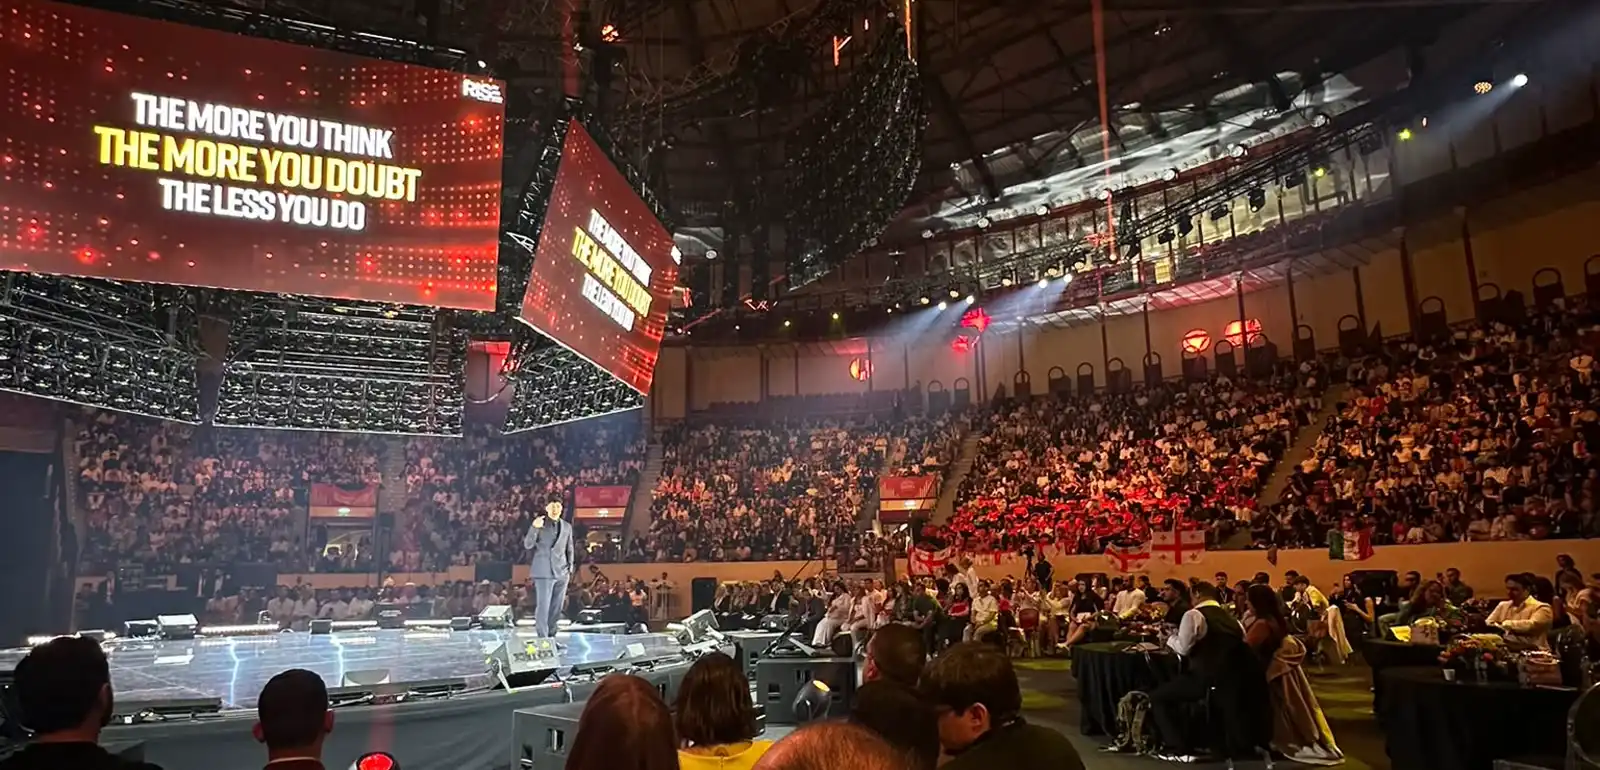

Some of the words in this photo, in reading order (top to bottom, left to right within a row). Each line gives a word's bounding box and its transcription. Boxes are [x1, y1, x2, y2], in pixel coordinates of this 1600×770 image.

[463, 79, 501, 99] RISE
[131, 92, 186, 130] THE
[187, 101, 265, 141] MORE
[266, 112, 318, 148] YOU
[319, 121, 393, 159] THINK
[94, 125, 160, 170] THE
[163, 135, 258, 182] MORE
[259, 148, 322, 190] YOU
[326, 157, 422, 202] DOUBT
[157, 178, 211, 214] THE
[213, 184, 276, 220] LESS
[278, 193, 328, 227] YOU
[331, 199, 366, 231] DO
[572, 226, 595, 267] THE
[590, 243, 617, 288] MORE
[613, 264, 632, 300] YOU
[627, 279, 653, 318] DOUBT
